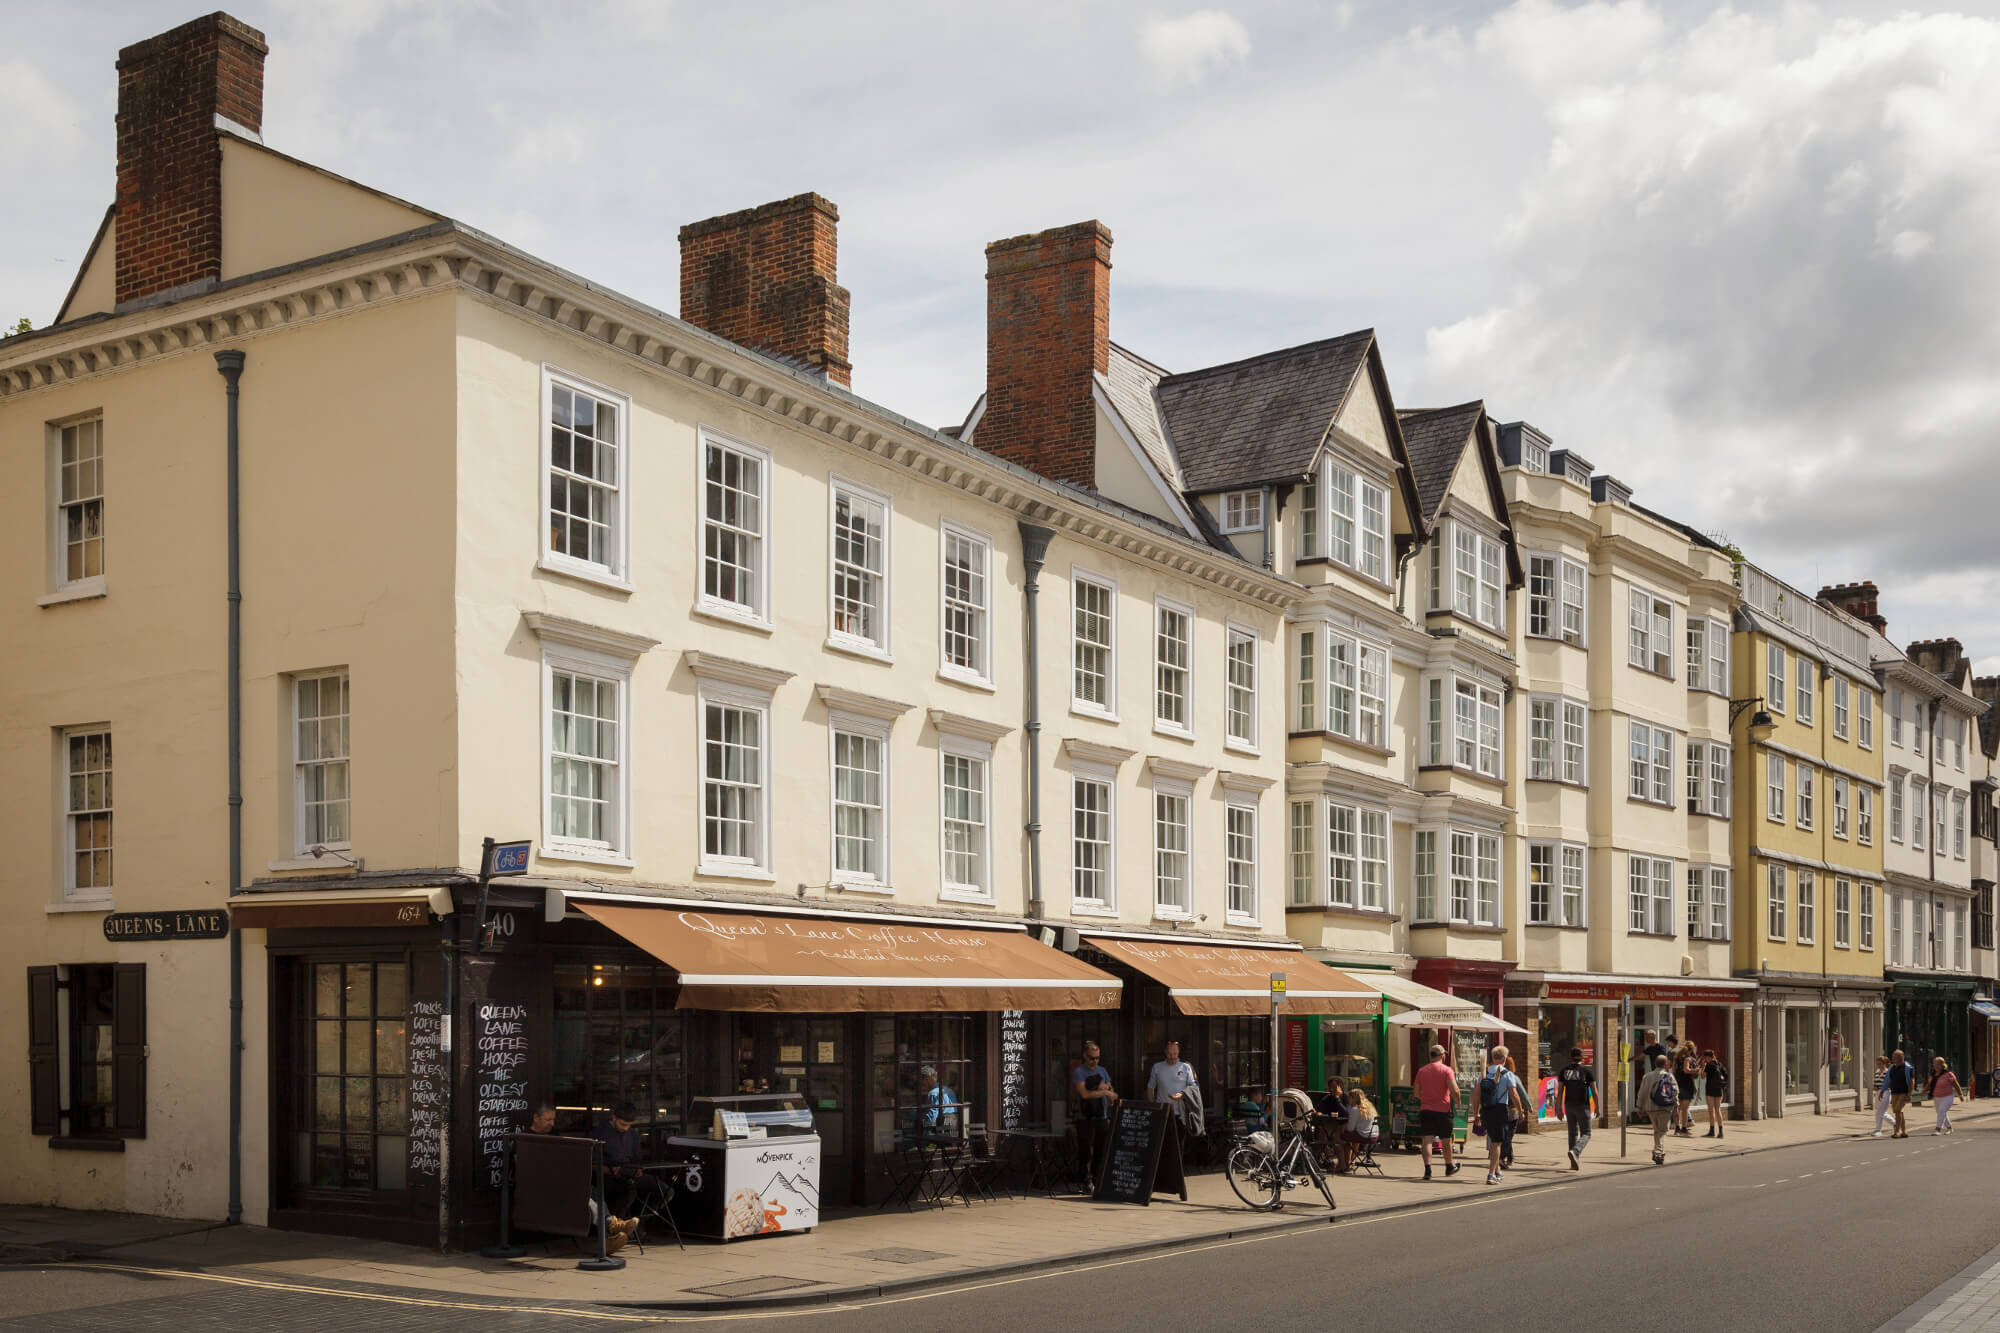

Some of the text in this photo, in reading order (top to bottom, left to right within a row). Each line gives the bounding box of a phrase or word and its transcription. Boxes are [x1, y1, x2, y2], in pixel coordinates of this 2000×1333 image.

[397, 906, 420, 920] 1654
[105, 918, 163, 934] QUEENS
[176, 915, 220, 932] LANE
[785, 923, 845, 940] Lane
[847, 926, 919, 949] Coffee
[922, 930, 988, 946] House
[413, 1001, 442, 1015] TURKIS
[413, 1017, 441, 1030] COFFE
[484, 1022, 523, 1035] LANE
[478, 1037, 529, 1051] COFFEE
[412, 1048, 437, 1061] FRESH
[481, 1052, 528, 1067] HOUSE
[480, 1081, 528, 1098] OLDEST
[479, 1099, 529, 1112] ESTABLISHED
[479, 1115, 509, 1128] COFFEE
[480, 1127, 511, 1139] HOUSE
